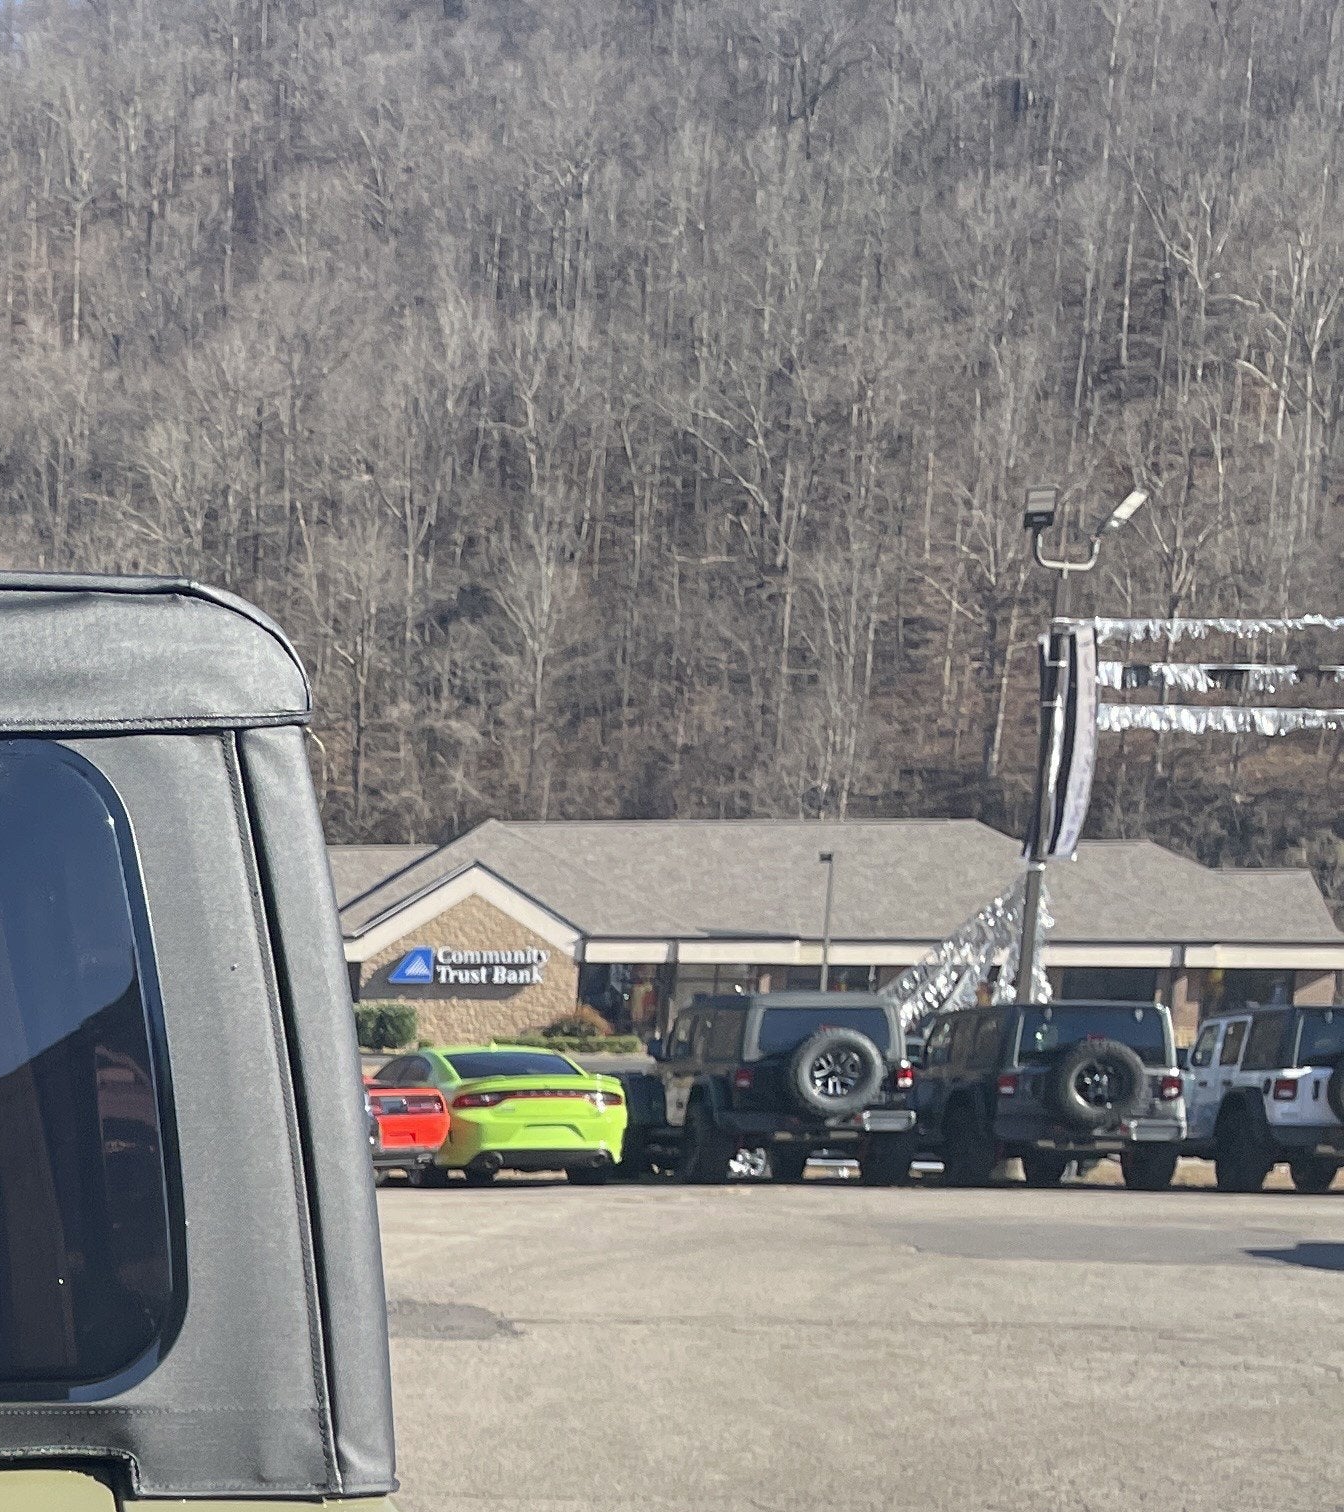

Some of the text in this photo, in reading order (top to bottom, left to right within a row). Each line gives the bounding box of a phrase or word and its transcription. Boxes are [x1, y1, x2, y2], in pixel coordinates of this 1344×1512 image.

[436, 945, 550, 968] Community
[436, 965, 544, 985] Trust Bank
